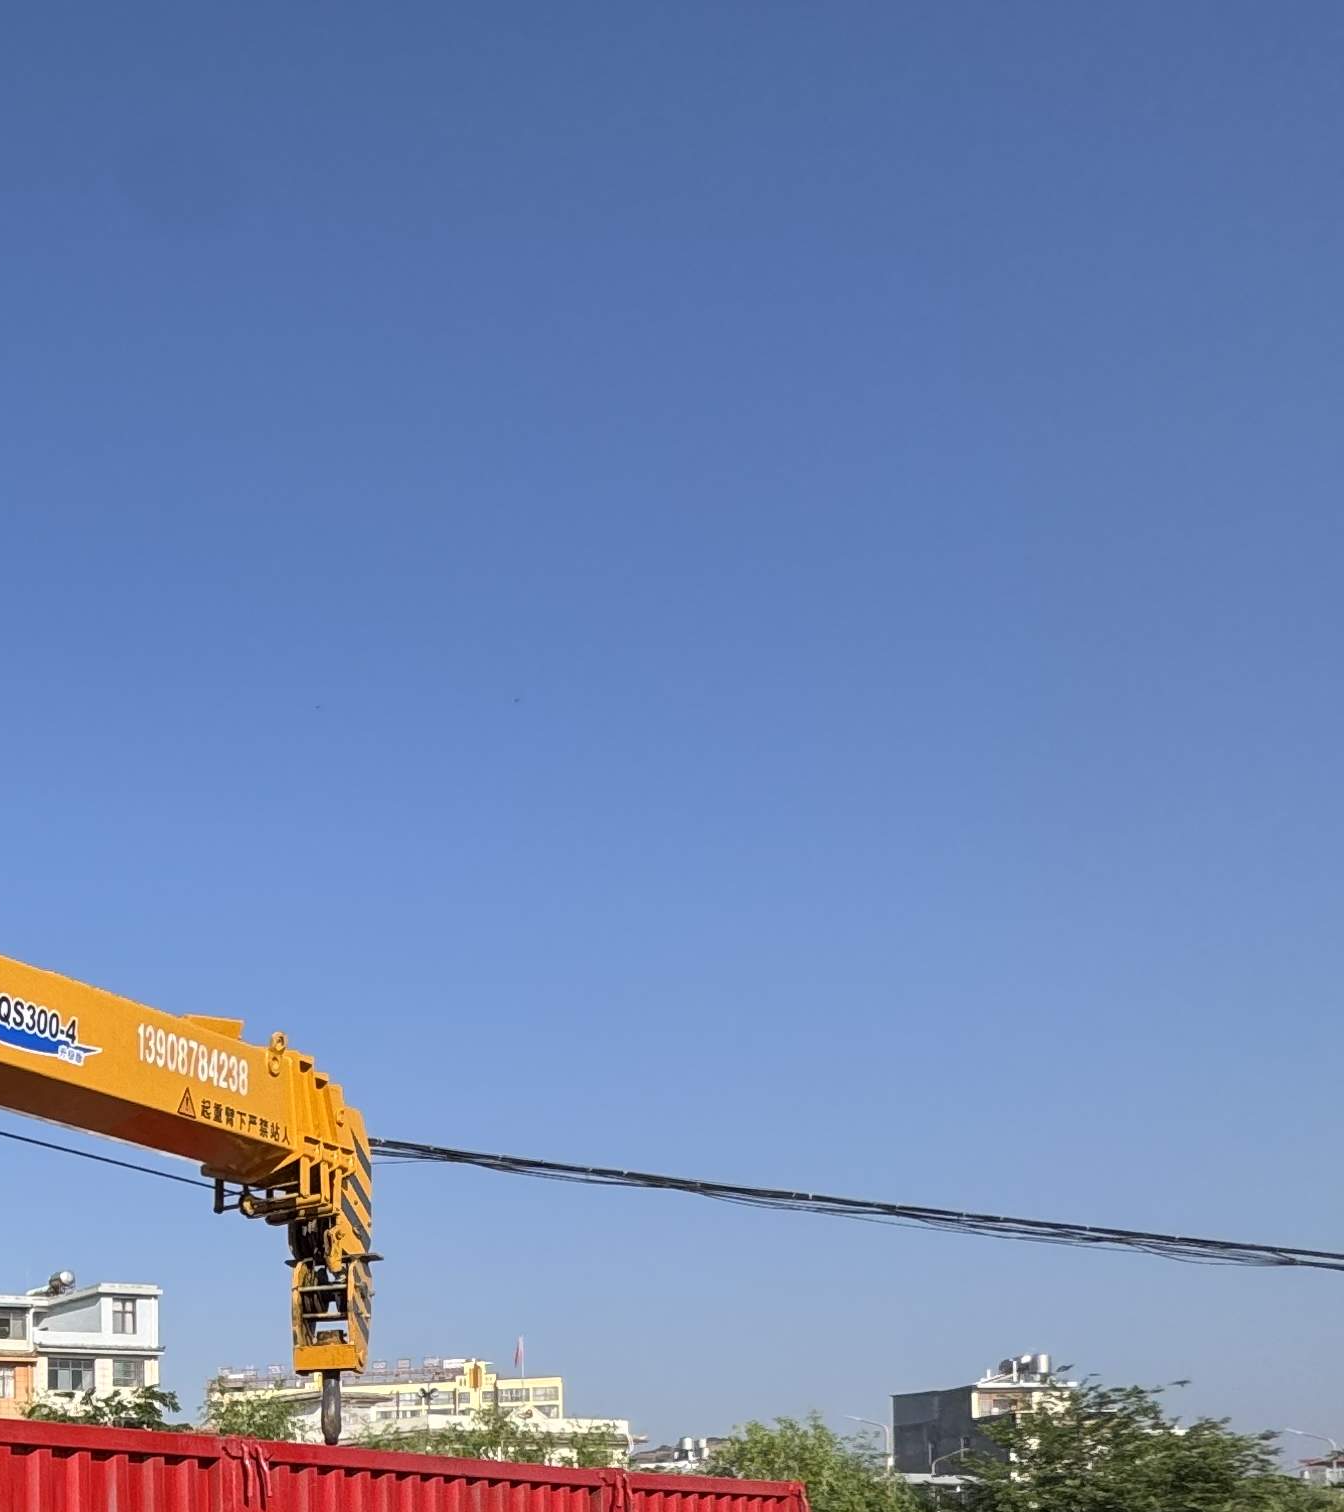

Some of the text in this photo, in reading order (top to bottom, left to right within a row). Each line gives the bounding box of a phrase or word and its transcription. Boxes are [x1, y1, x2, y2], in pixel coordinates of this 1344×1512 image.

[137, 1023, 248, 1096] 13908784238
[201, 1098, 290, 1145] 起重臂下严禁站人
